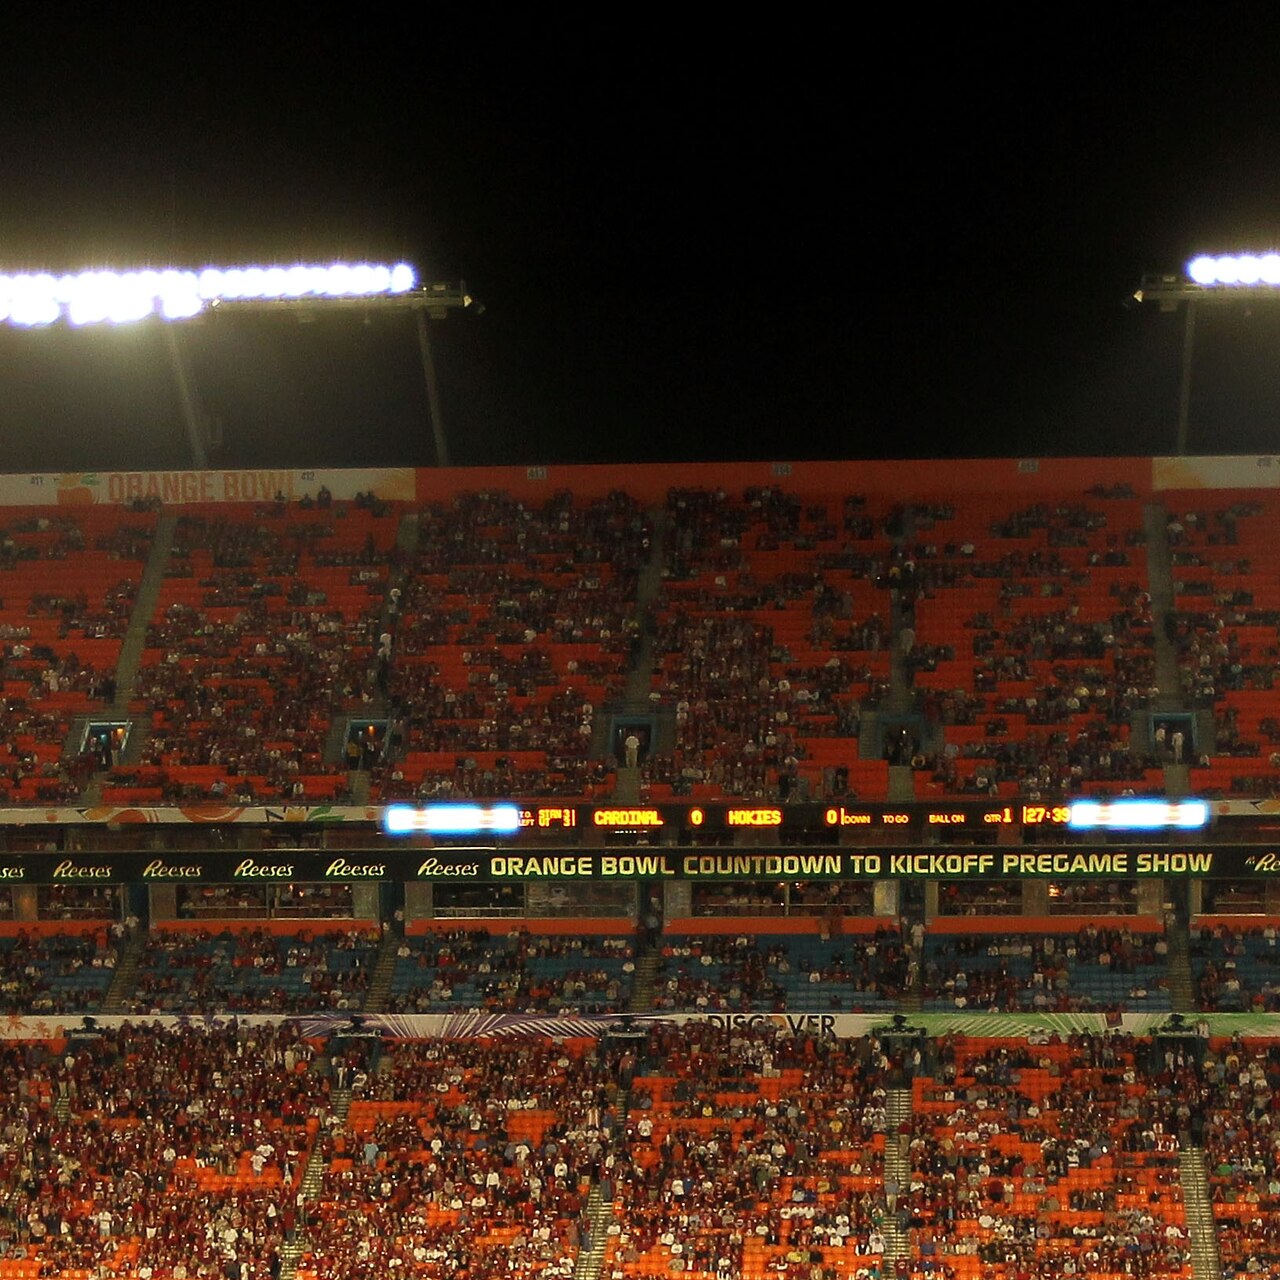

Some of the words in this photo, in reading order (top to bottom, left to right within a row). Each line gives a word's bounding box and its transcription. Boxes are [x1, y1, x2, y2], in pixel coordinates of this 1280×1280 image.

[108, 471, 215, 501] ORANGE
[223, 470, 300, 500] BOWL
[538, 809, 562, 819] STAN
[594, 811, 663, 826] CARDINAL
[691, 810, 703, 825] 0
[729, 811, 781, 825] HOKIES
[826, 809, 837, 825] 0
[845, 815, 870, 824] DOWN
[882, 814, 894, 824] TO
[895, 814, 908, 824] GO
[929, 814, 949, 824] BALL
[951, 814, 964, 824] ON
[984, 814, 1001, 824] QTR
[1003, 808, 1011, 823] 1
[1027, 808, 1070, 823] 27:39
[53, 860, 113, 878] Reese's
[143, 859, 203, 878] Reese's
[234, 859, 294, 877] Reese's
[326, 858, 386, 877] Reese's
[418, 858, 479, 877] Reese's
[491, 857, 592, 876] ORANGE
[602, 856, 674, 875] BOWL
[684, 855, 841, 875] COUNTDOWN
[850, 855, 880, 874] TO
[890, 855, 995, 874] KICKOFF
[1003, 854, 1127, 873] PREGAME
[1136, 853, 1213, 873] SHOW
